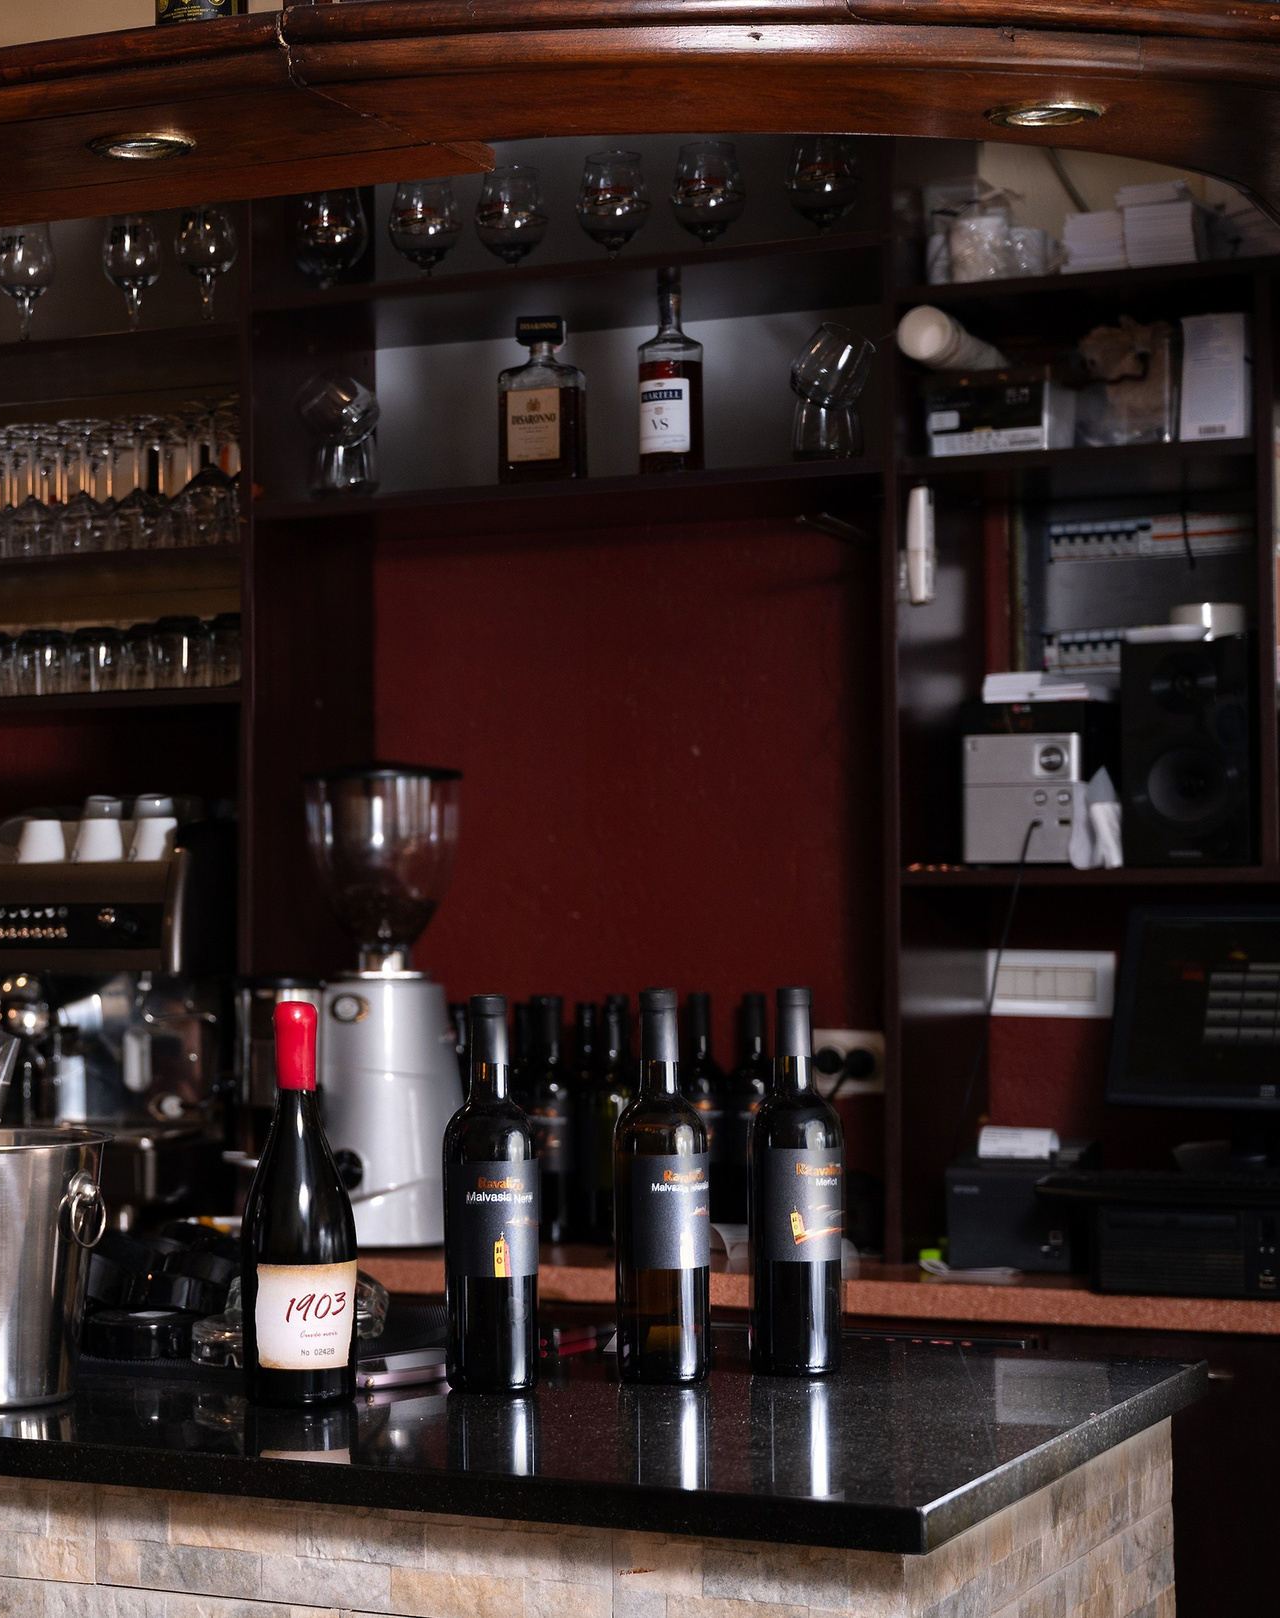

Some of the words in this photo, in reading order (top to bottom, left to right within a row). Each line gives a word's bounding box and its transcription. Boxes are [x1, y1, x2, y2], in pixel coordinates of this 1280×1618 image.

[511, 413, 557, 426] DISARONNO
[815, 1177, 838, 1187] Merlot
[466, 1191, 513, 1203] Malvasia
[285, 1291, 347, 1323] 1903
[314, 1347, 335, 1356] 02428
